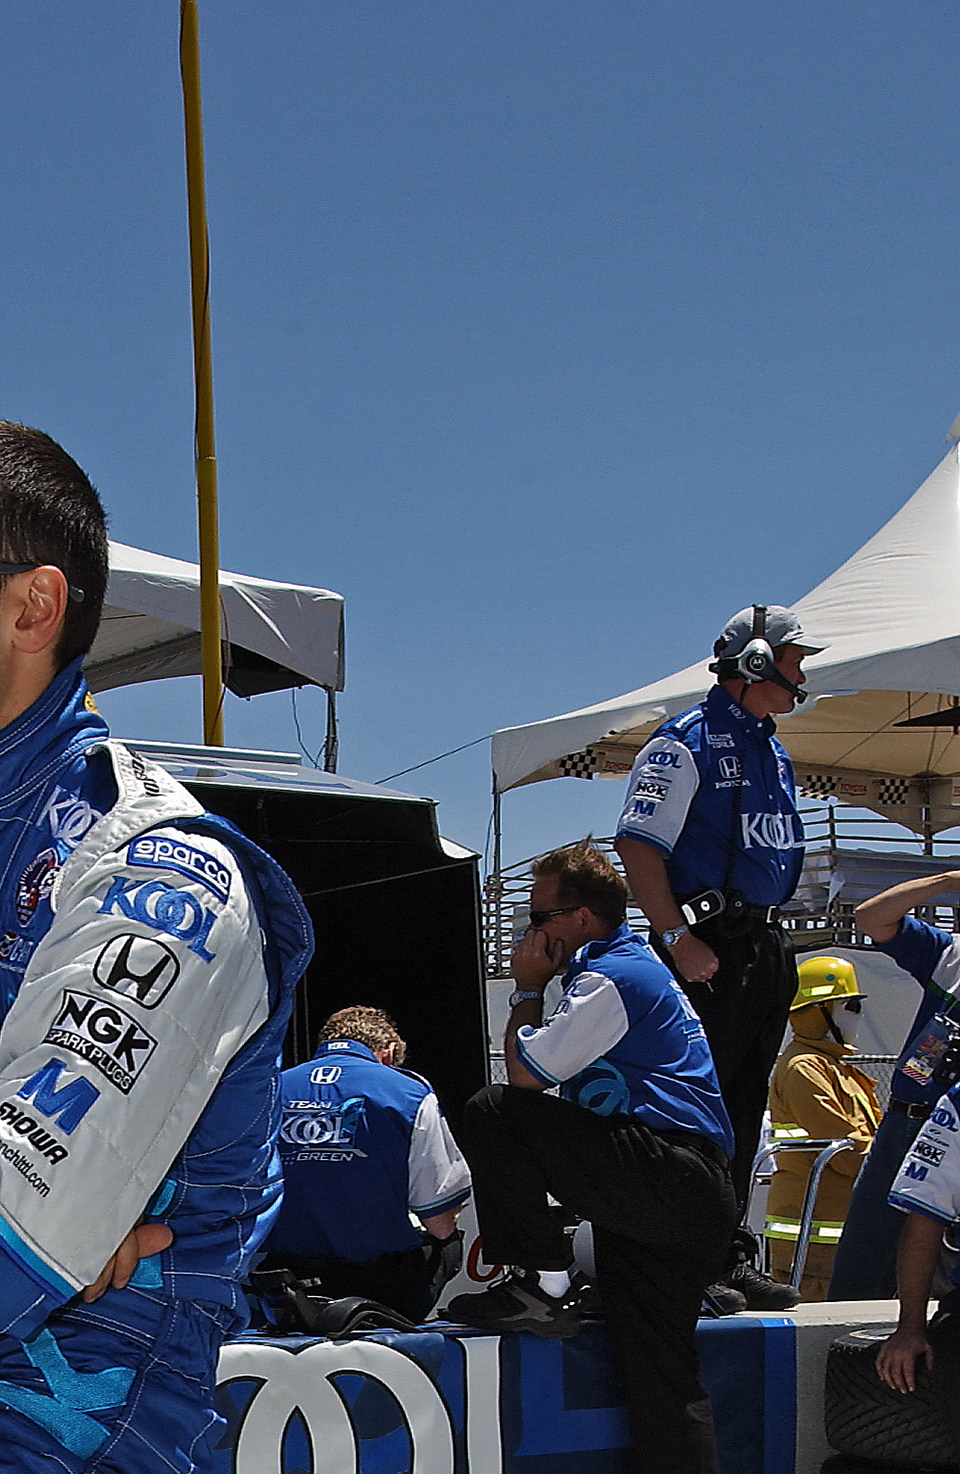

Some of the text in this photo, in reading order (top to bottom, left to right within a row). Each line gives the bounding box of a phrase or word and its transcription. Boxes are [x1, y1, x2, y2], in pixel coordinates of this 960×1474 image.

[741, 813, 806, 850] KOOL
[135, 839, 230, 888] sparco
[100, 876, 218, 963] KOOL
[56, 994, 149, 1072] NGK
[89, 1046, 132, 1091] PLUGS
[17, 1057, 101, 1136] M
[289, 1100, 332, 1109] TEAM
[280, 1115, 351, 1145] KOOL
[296, 1152, 354, 1162] GREEN
[905, 1162, 928, 1181] M
[913, 1143, 943, 1163] NGK
